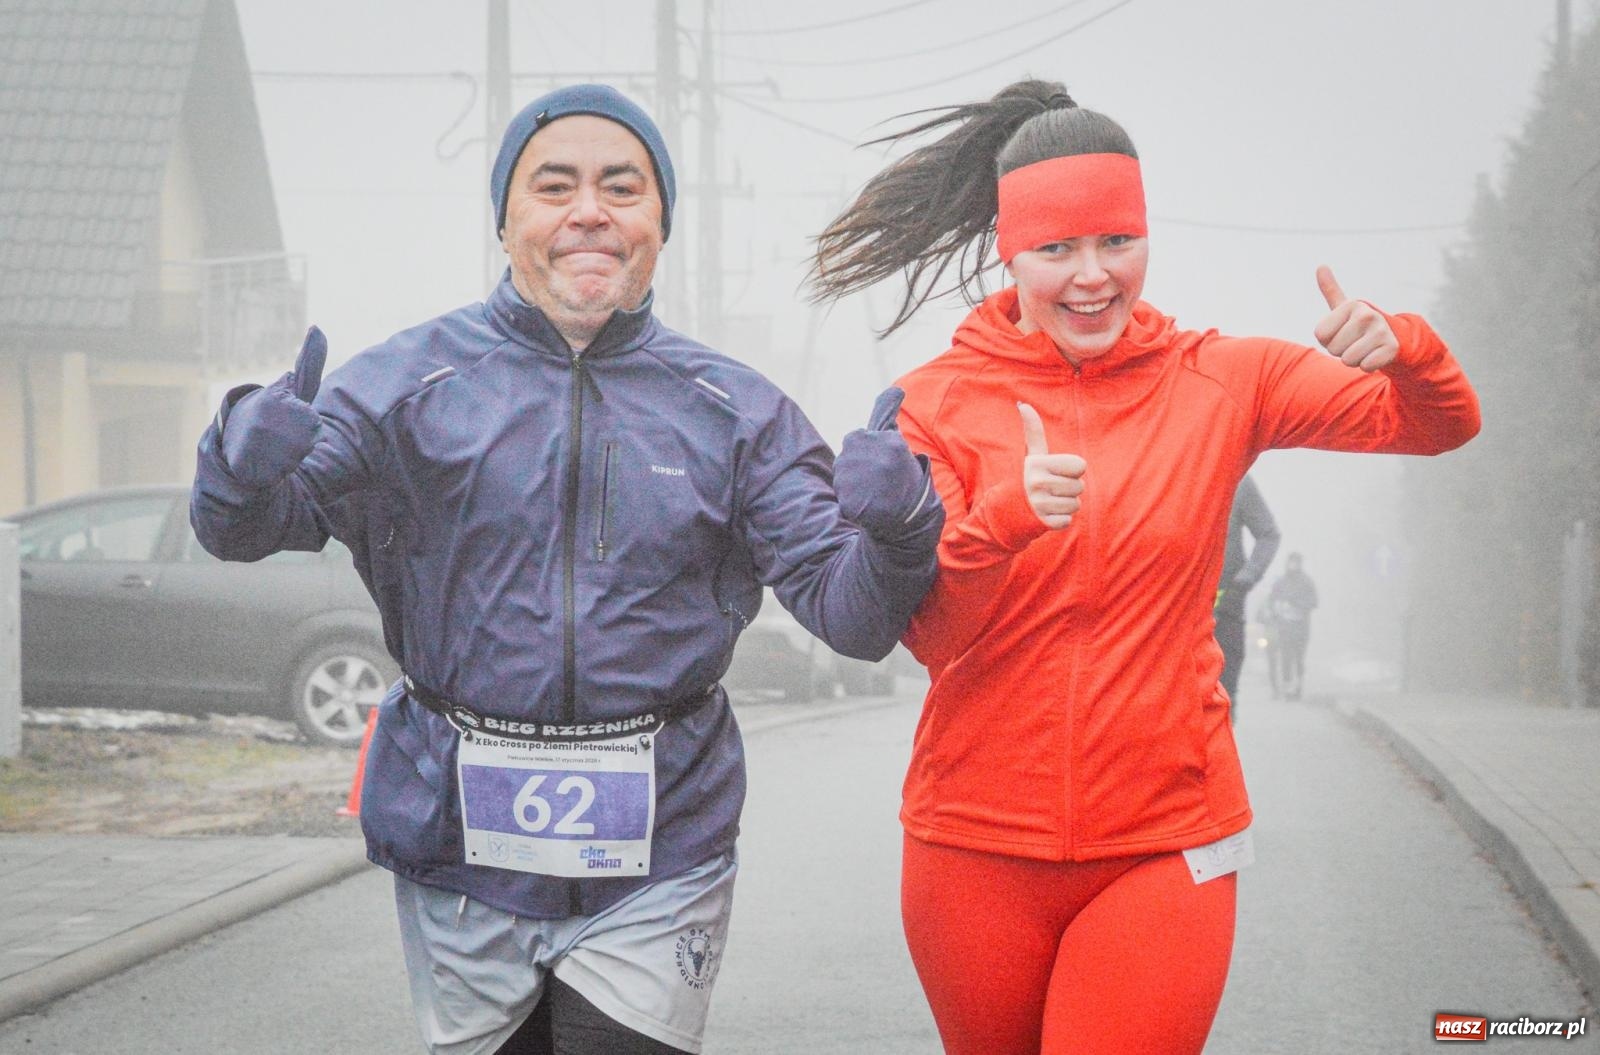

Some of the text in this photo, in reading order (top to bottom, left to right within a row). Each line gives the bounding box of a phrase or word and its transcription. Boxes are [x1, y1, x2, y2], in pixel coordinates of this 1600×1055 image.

[651, 464, 685, 476] KIPRUN
[475, 737, 638, 755] X Eko Cross po Ziemi Pietrowickiej
[513, 775, 595, 834] 62
